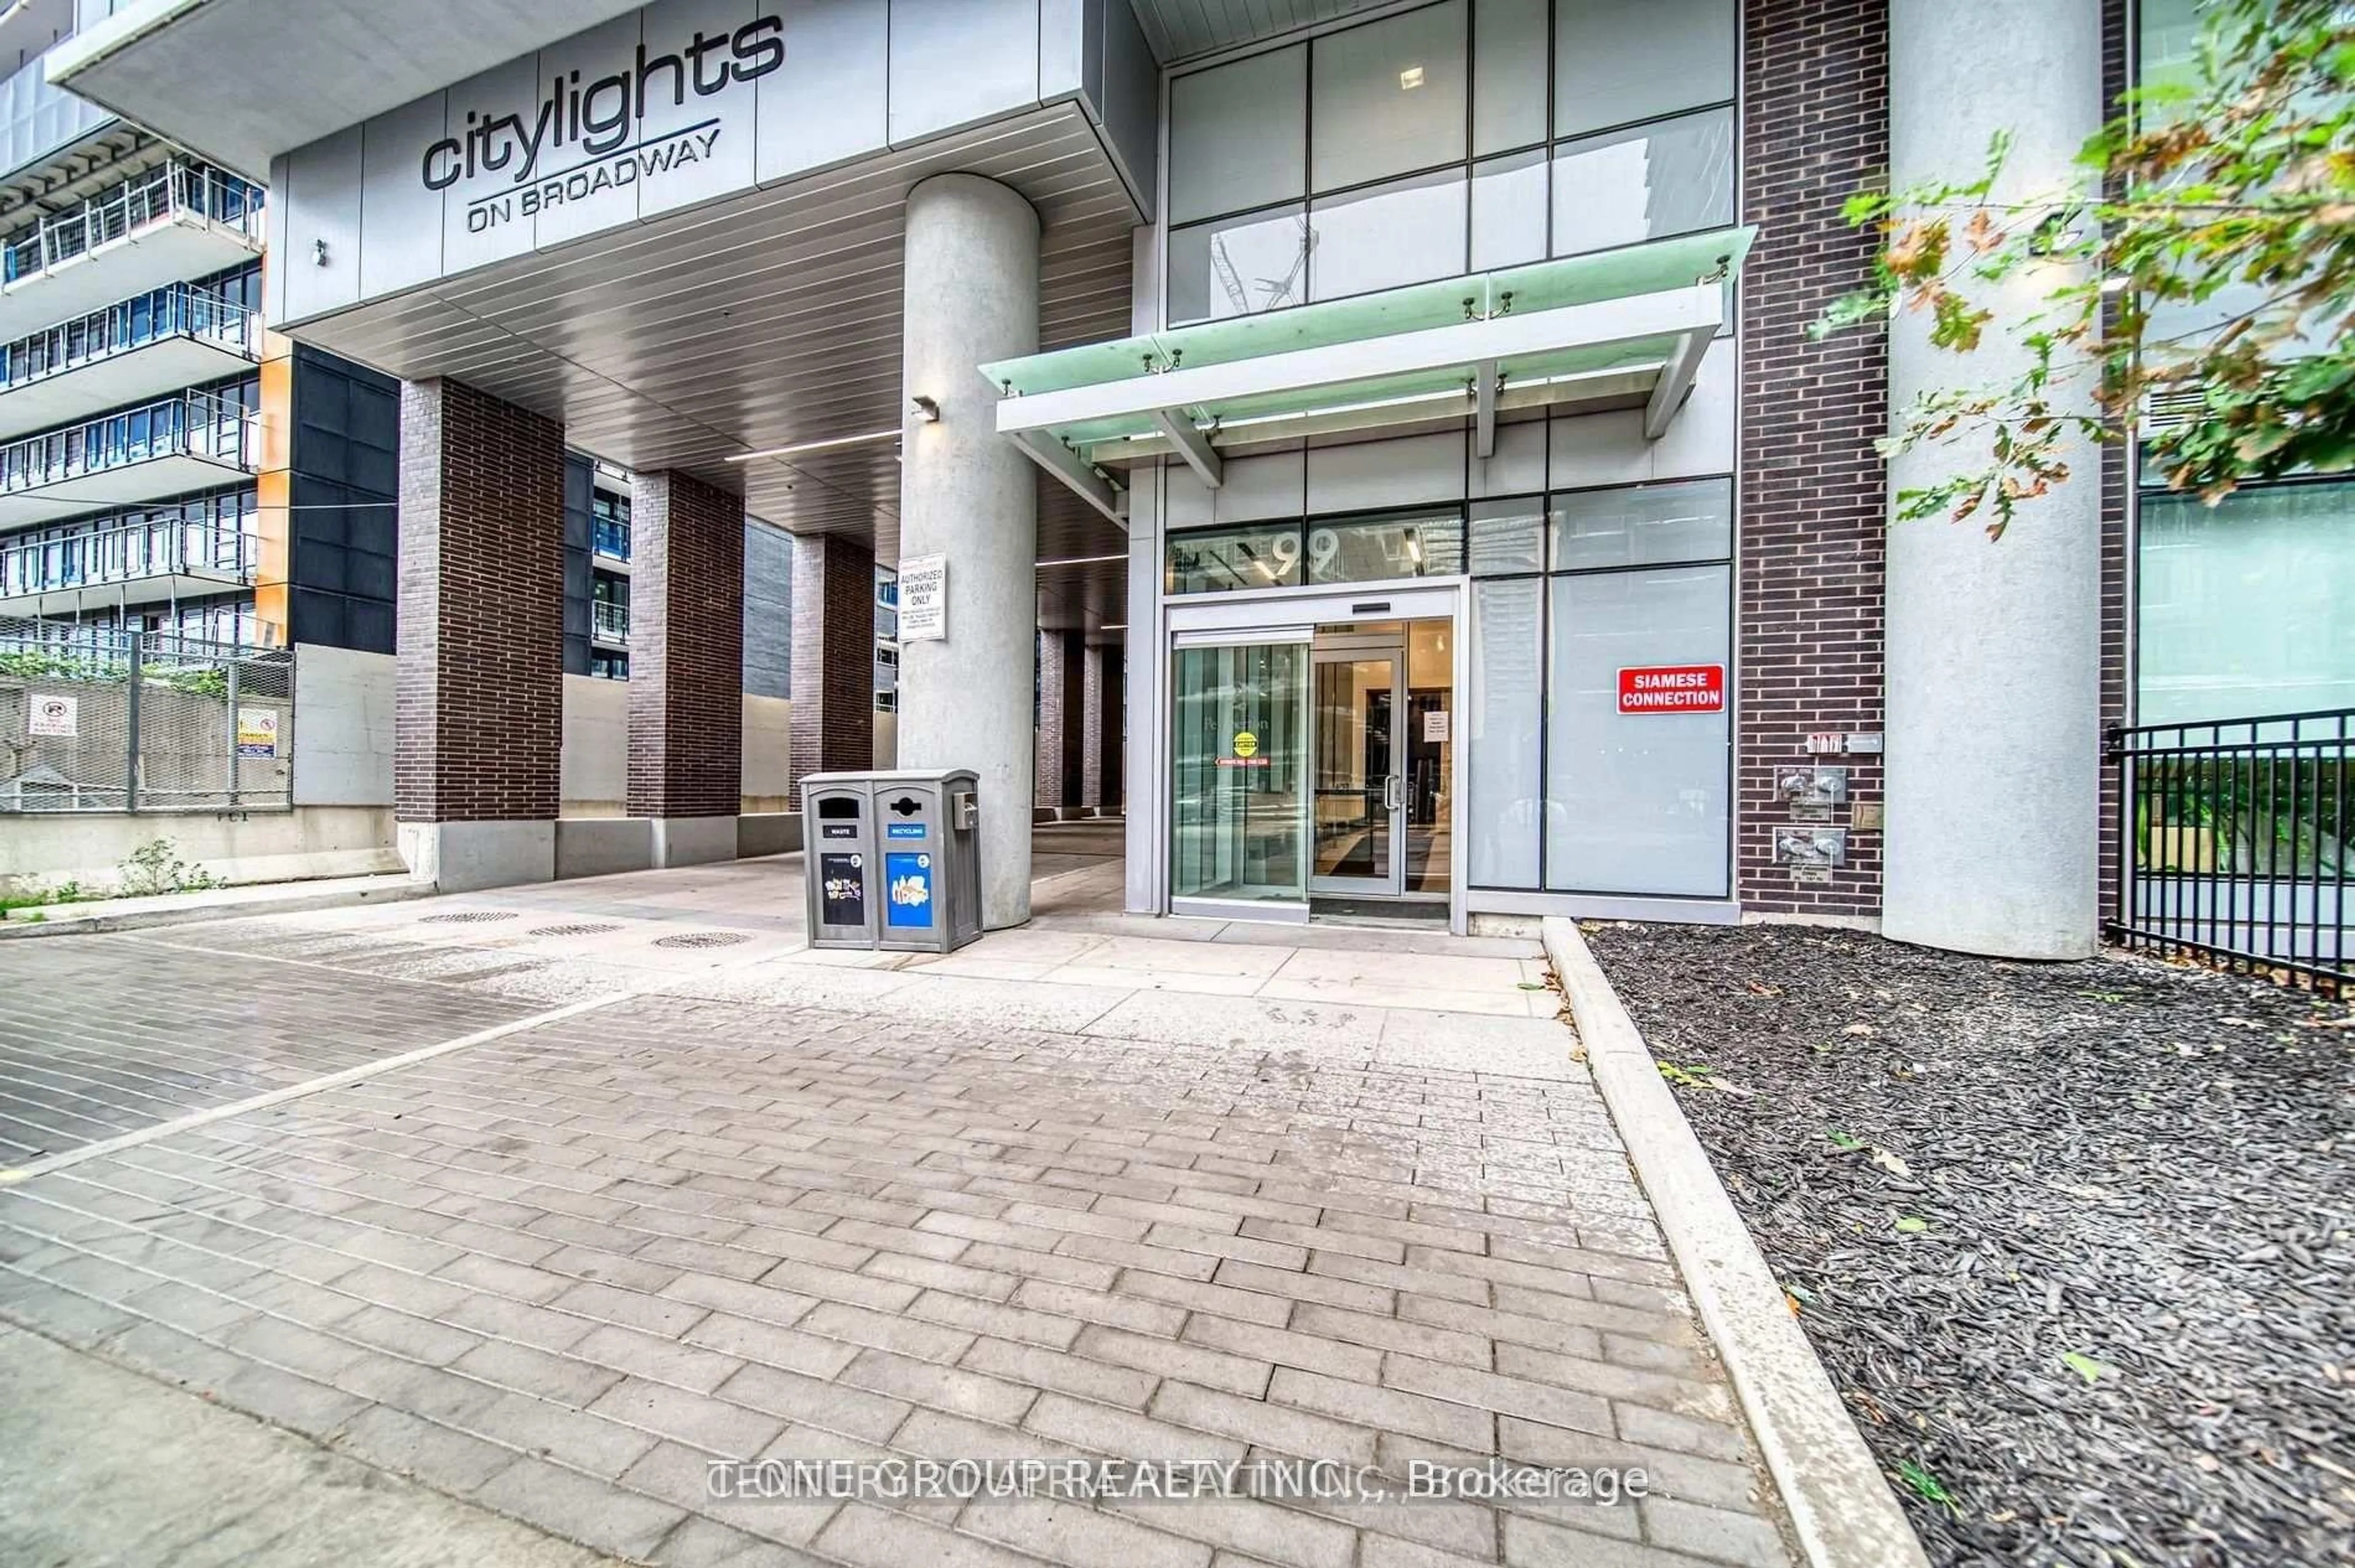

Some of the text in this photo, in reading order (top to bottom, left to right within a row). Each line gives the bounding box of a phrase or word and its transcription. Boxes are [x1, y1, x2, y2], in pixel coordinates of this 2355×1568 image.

[423, 15, 784, 190] citylights
[467, 129, 721, 233] ON BROADWAY
[1273, 529, 1339, 575] 99
[902, 570, 942, 583] AUTHORIZED
[905, 581, 936, 595] PARKING
[912, 594, 930, 605] ONLY
[1634, 673, 1707, 689] SIAMESE
[1623, 690, 1720, 706] CONNECTION
